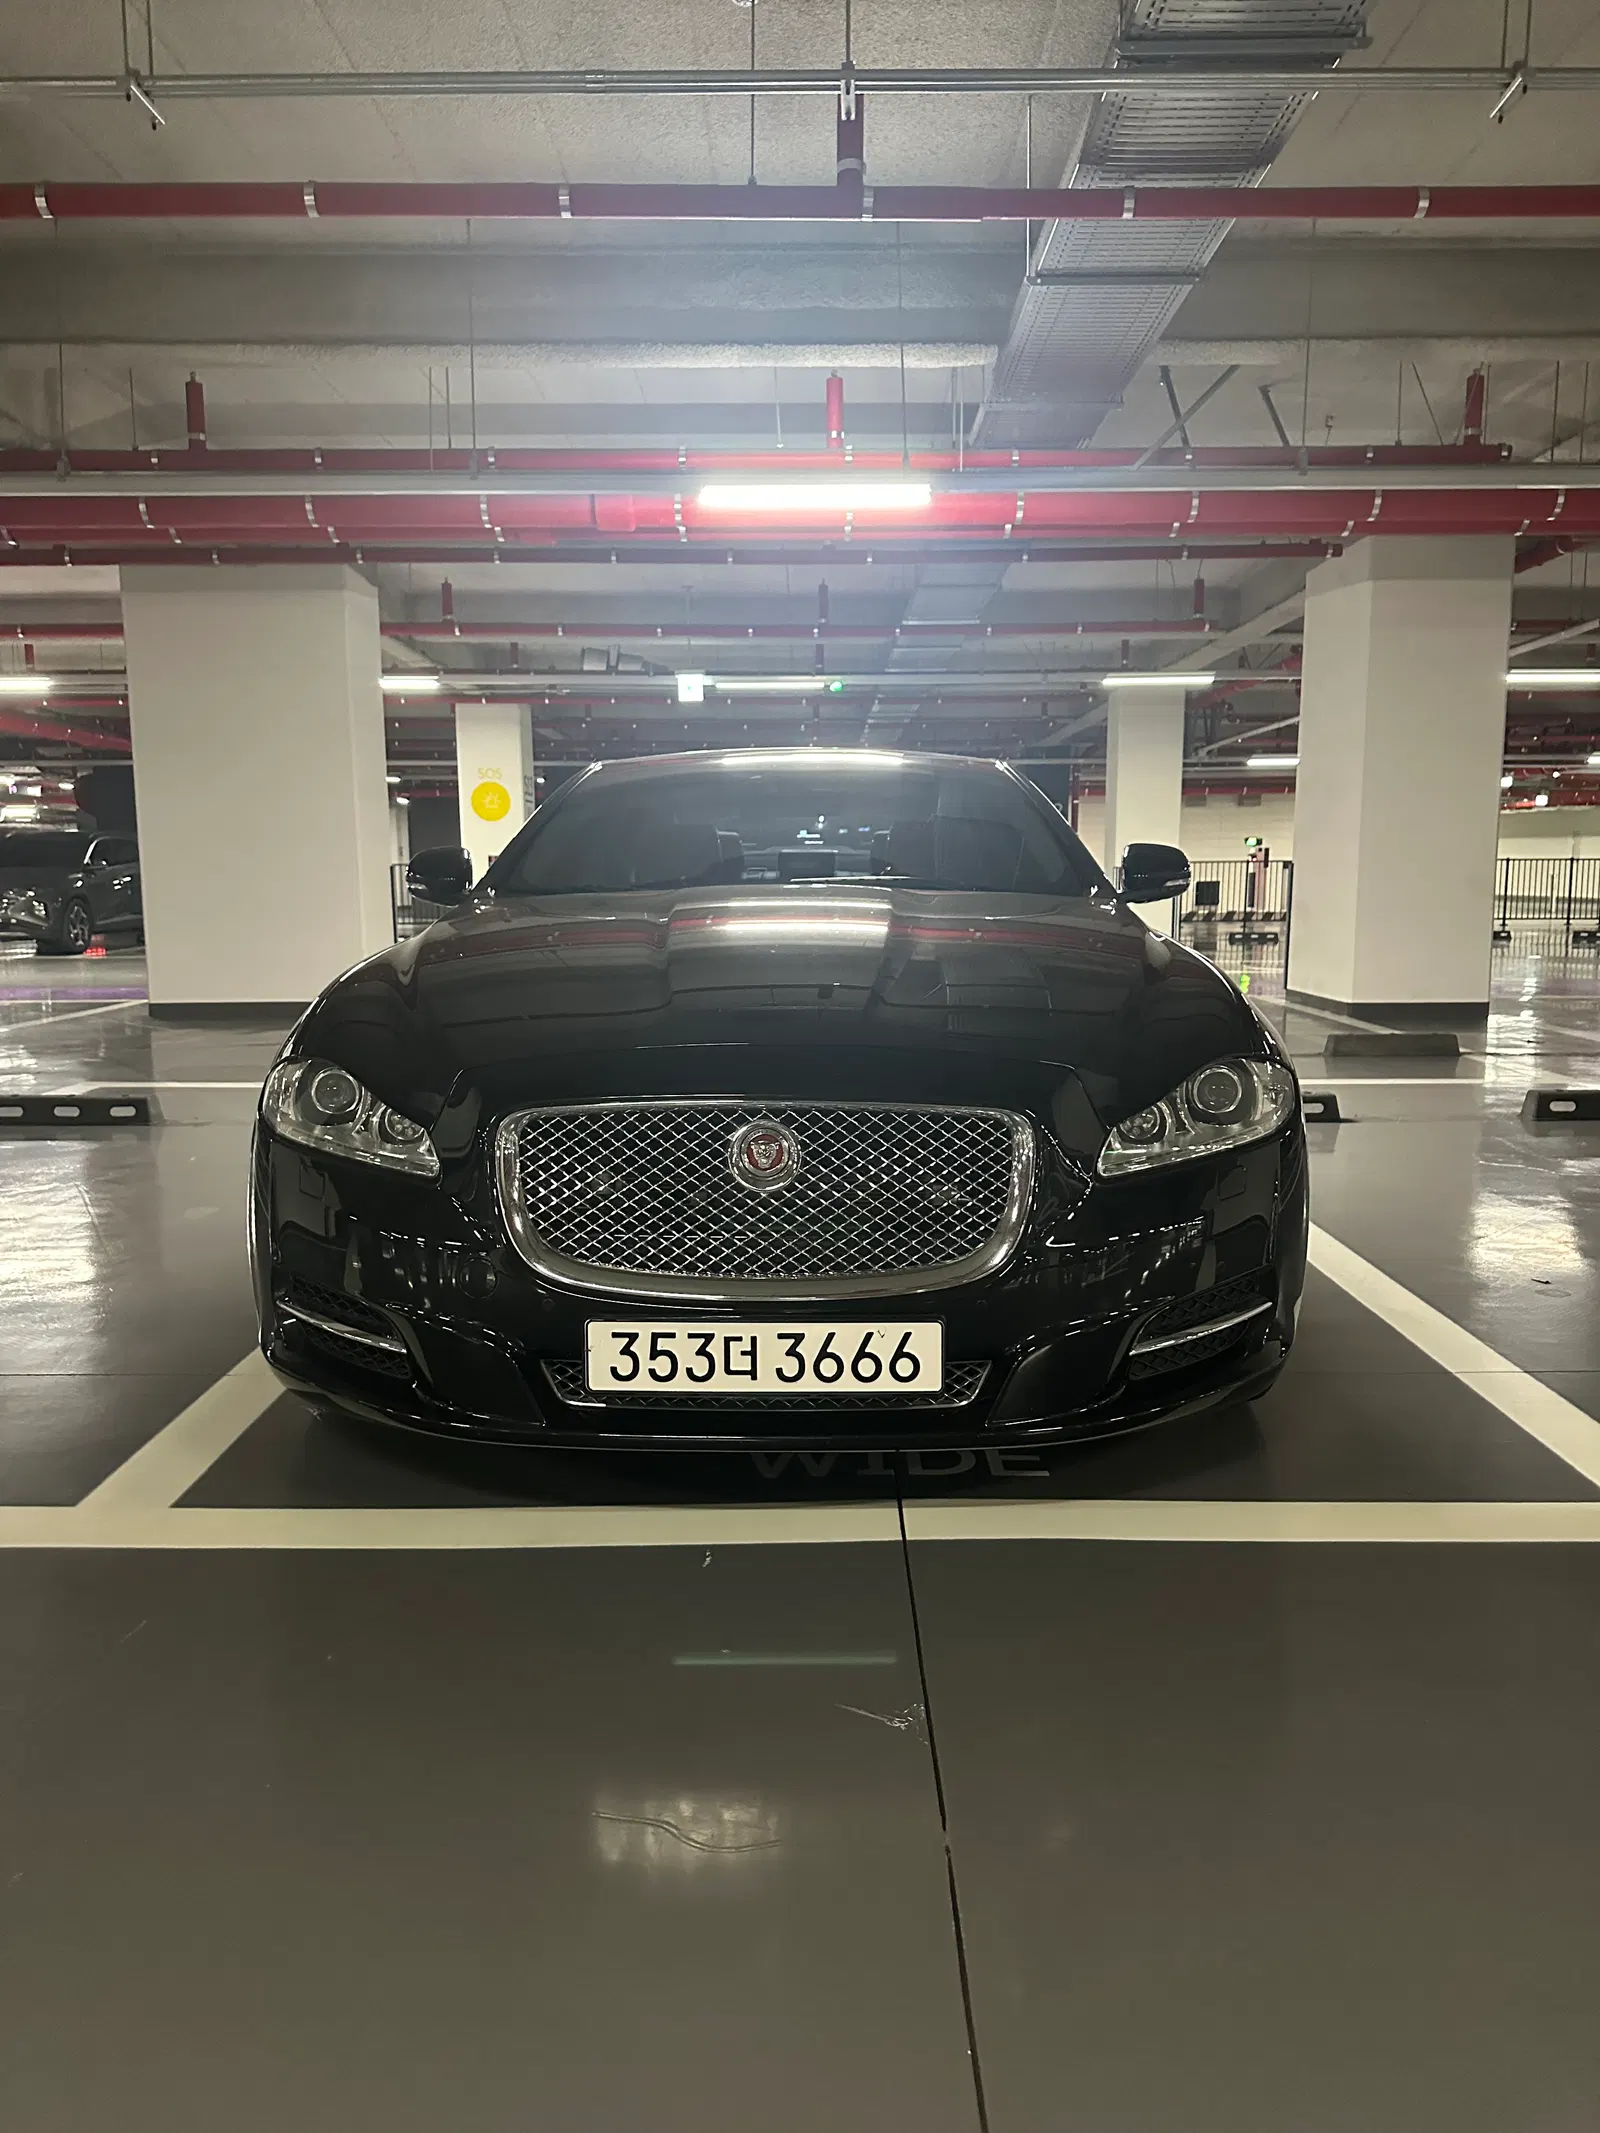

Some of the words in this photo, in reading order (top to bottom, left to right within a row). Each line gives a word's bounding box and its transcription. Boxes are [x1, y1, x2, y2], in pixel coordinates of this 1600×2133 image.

[477, 767, 502, 780] SOS
[609, 1331, 758, 1383] 353더
[775, 1331, 921, 1383] 3666
[748, 1449, 1051, 1479] WIDE
